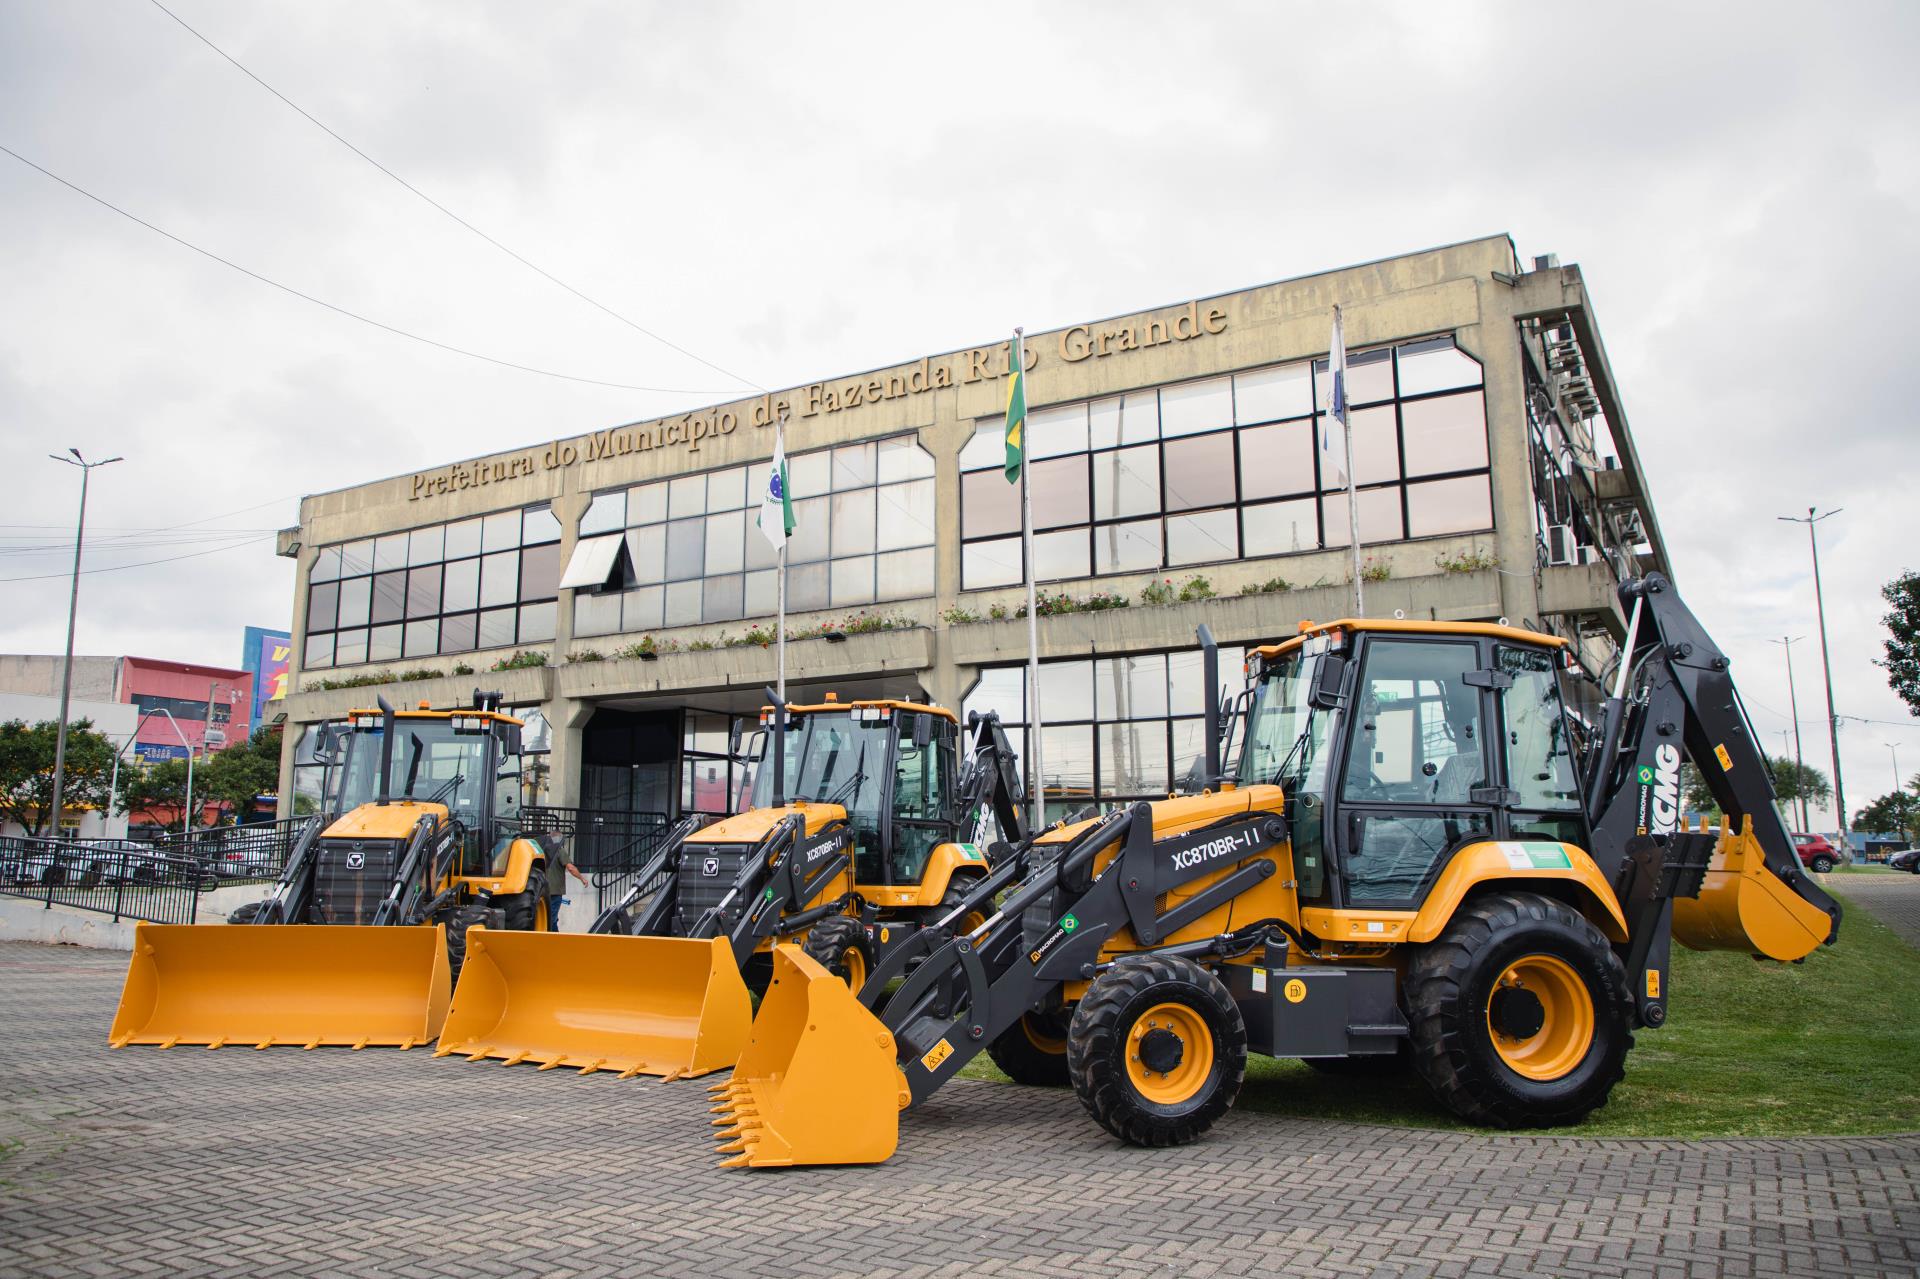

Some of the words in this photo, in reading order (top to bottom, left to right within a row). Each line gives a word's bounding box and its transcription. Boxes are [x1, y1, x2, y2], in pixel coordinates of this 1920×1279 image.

[408, 454, 535, 501] Prefeitura
[544, 440, 578, 471] do
[585, 408, 738, 462] Município
[751, 392, 790, 427] de
[802, 357, 953, 418] Fazenda
[963, 342, 1038, 384] Rio
[1058, 301, 1228, 362] Grande
